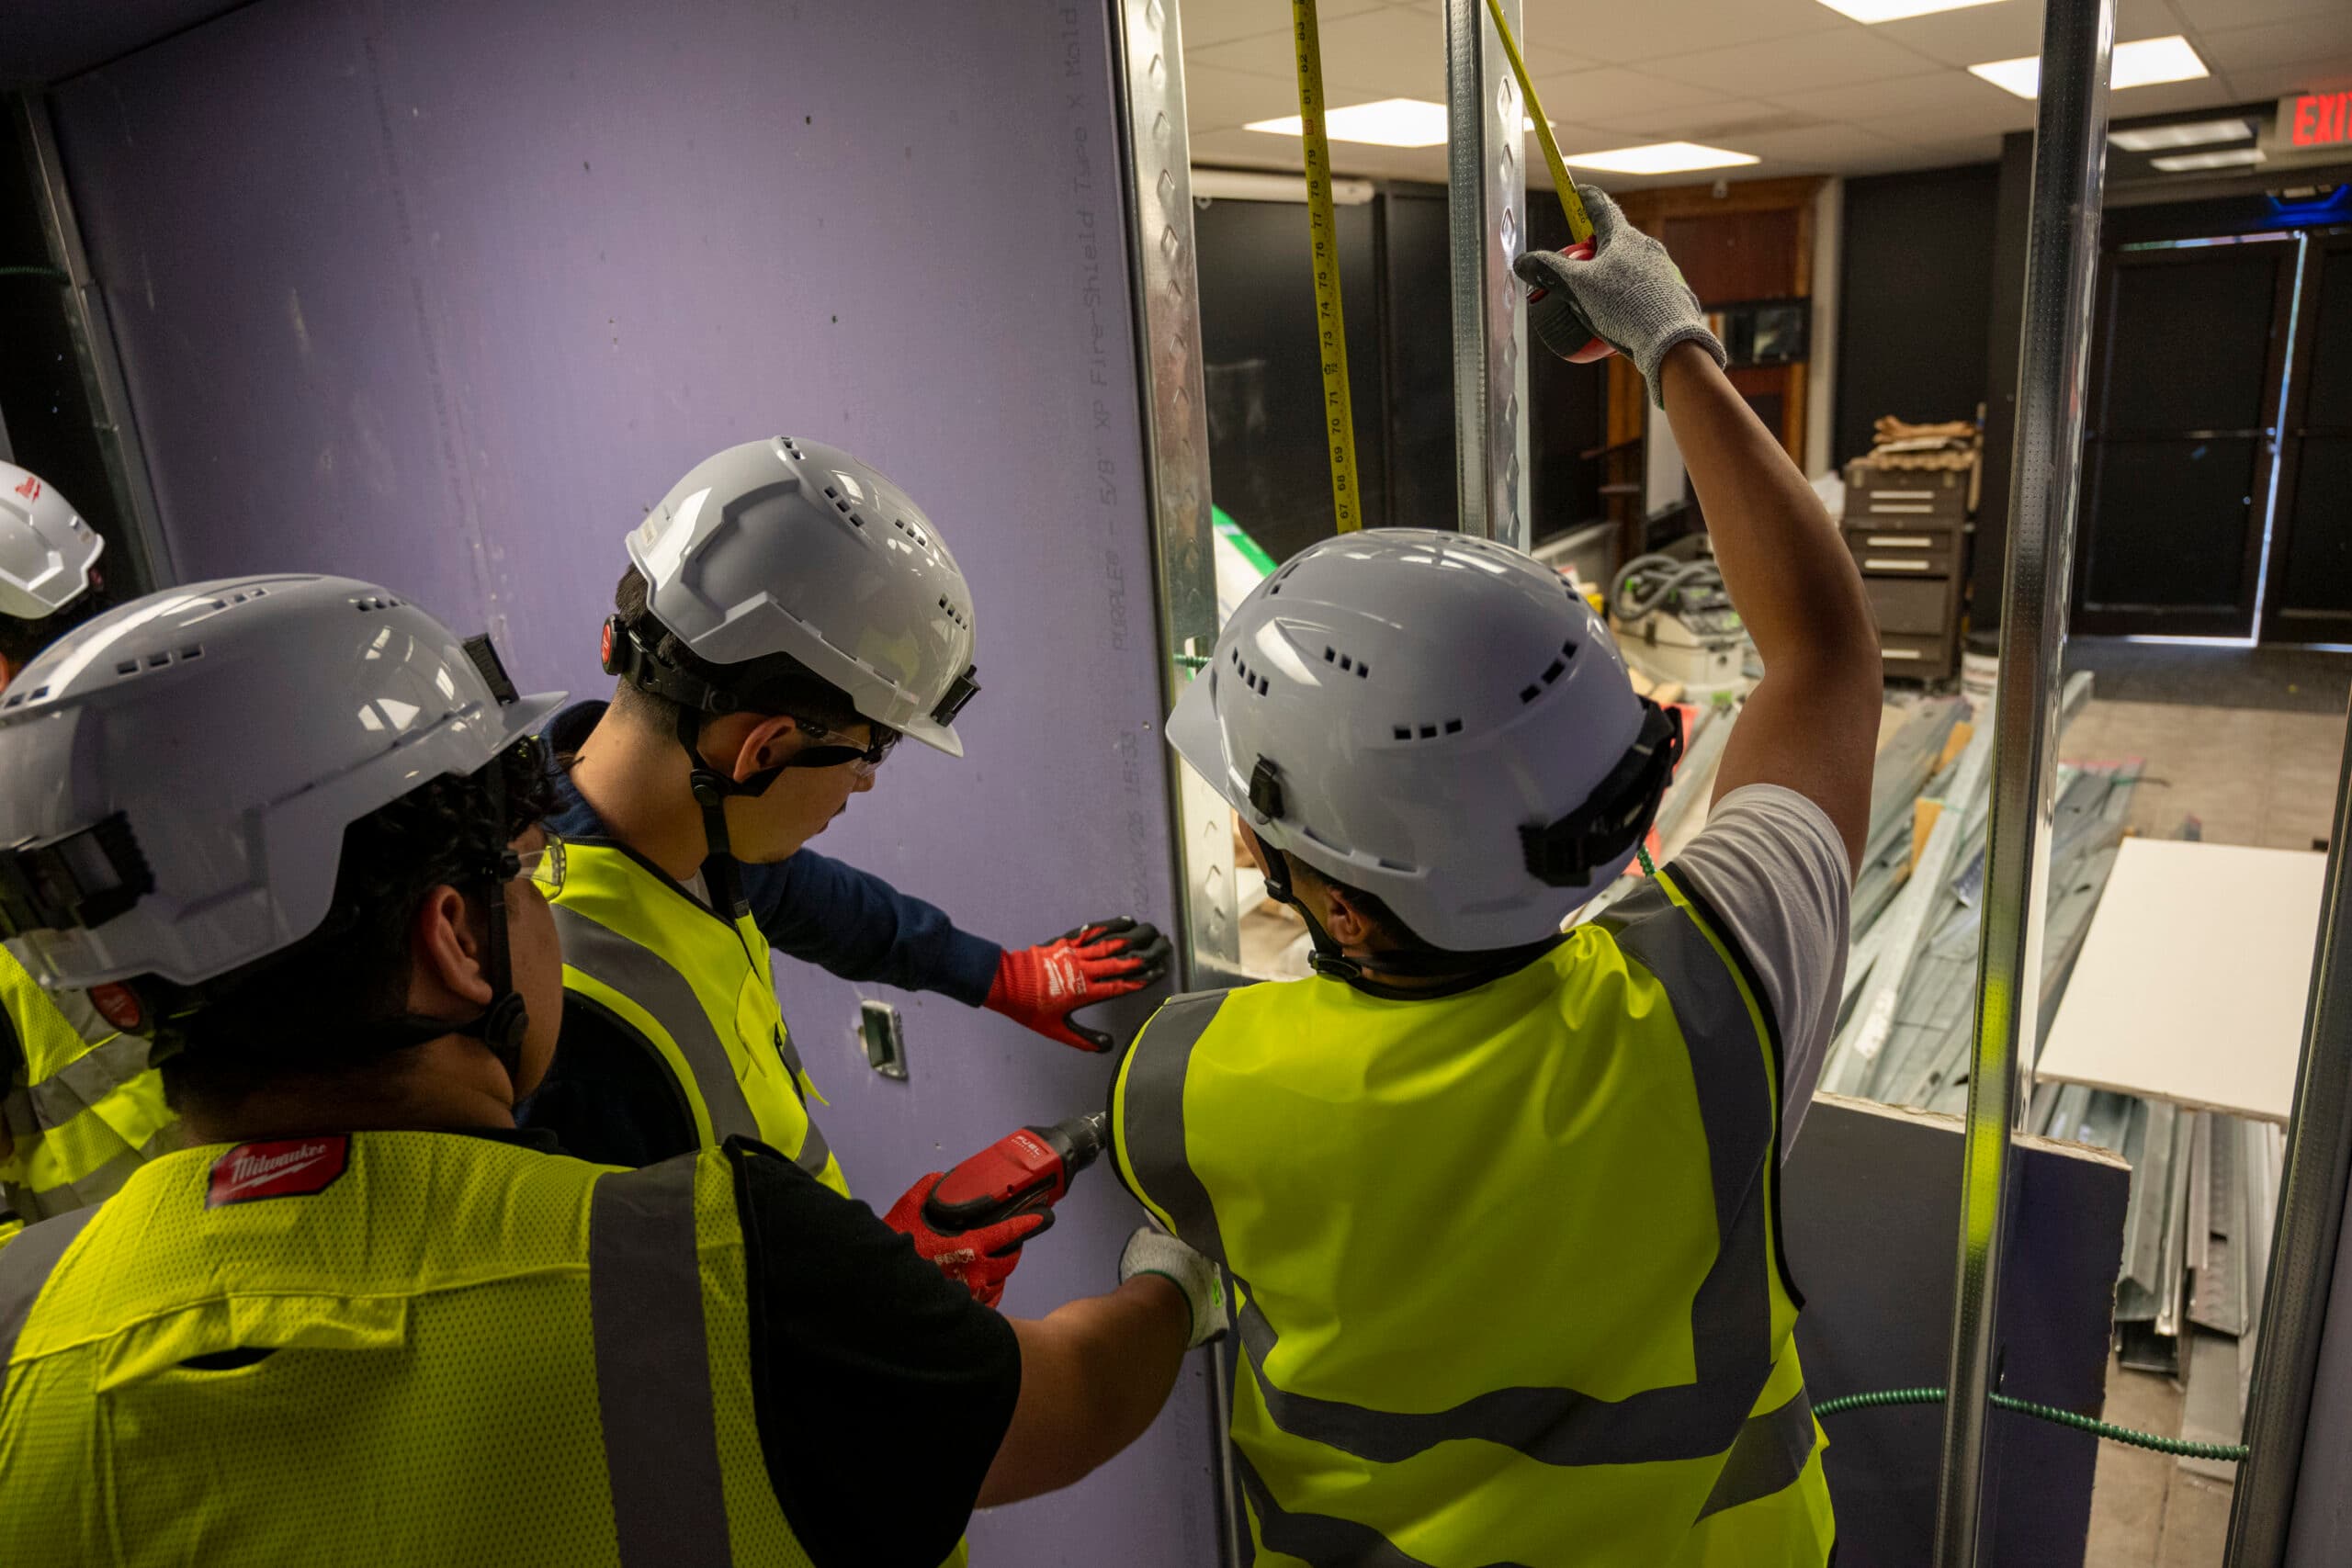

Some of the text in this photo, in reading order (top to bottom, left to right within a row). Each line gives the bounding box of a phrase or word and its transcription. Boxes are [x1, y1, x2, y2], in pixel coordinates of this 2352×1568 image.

[1059, 7, 1081, 78] Mold
[1066, 95, 1083, 111] X
[1073, 127, 1091, 195] Type
[1307, 149, 1317, 166] 79
[1314, 212, 1322, 229] 77
[1318, 271, 1328, 288] 75
[1076, 209, 1108, 386] Fire-Shield
[1321, 301, 1330, 319] 74
[1324, 331, 1333, 349] 73
[1329, 391, 1339, 406] 71
[1093, 399, 1111, 430] XP
[1332, 418, 1340, 434] 70
[1334, 446, 1343, 463] 69
[1337, 474, 1346, 491] 68
[1340, 503, 1349, 519] 67
[230, 1143, 328, 1185] Milwaukee
